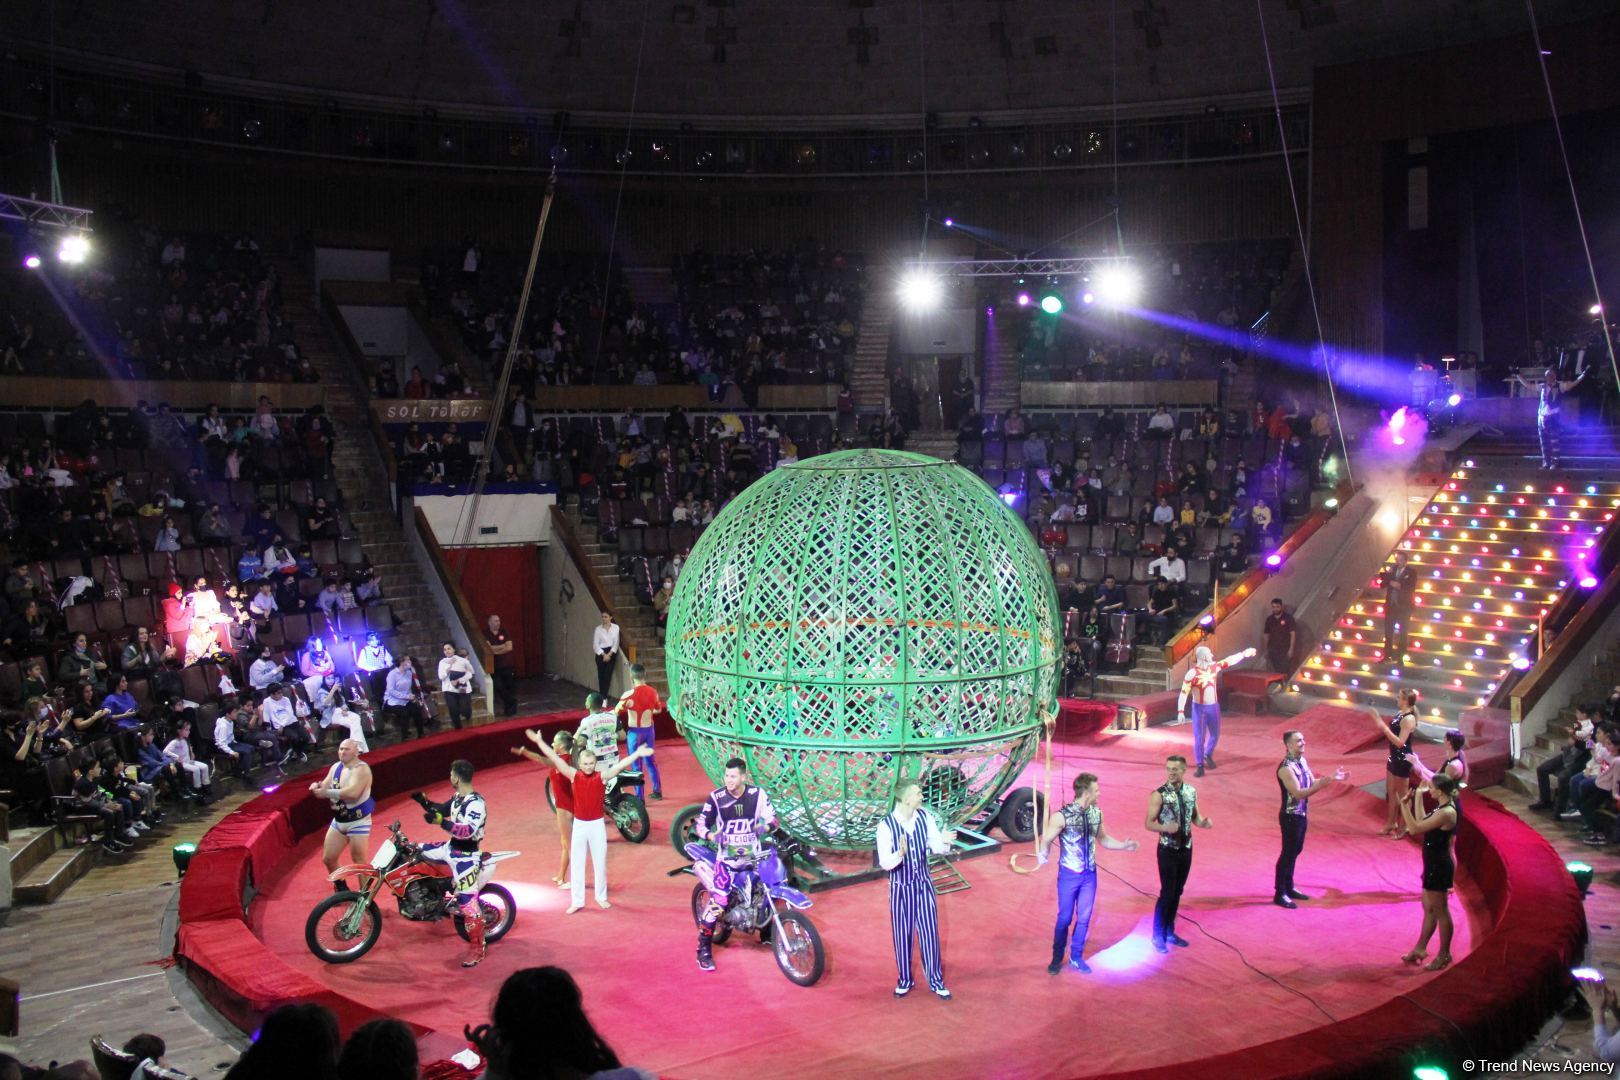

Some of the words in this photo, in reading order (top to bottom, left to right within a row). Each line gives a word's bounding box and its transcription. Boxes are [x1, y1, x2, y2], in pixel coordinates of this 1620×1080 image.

[387, 406, 420, 418] SOL
[715, 790, 727, 799] FOX
[725, 818, 755, 834] FOX
